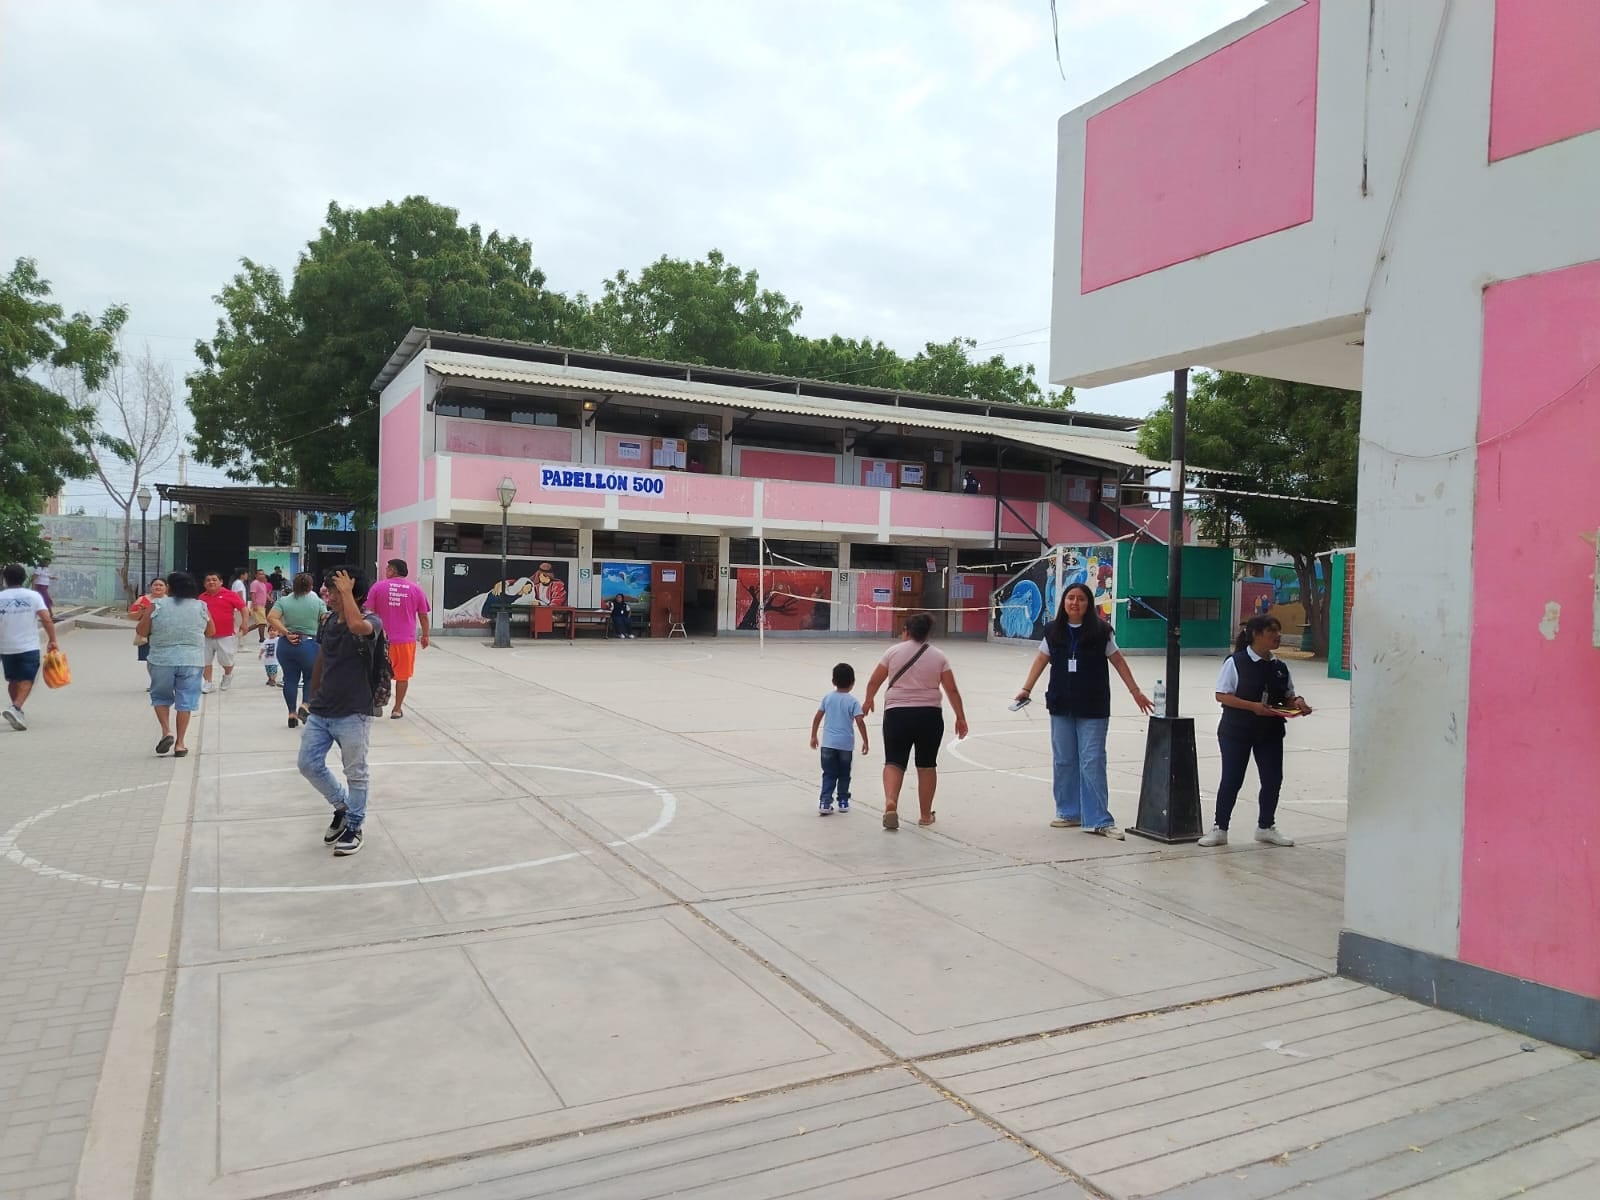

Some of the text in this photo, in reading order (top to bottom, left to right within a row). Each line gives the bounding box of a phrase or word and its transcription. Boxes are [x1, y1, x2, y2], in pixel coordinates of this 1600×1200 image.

[632, 476, 664, 494] 500
[423, 559, 432, 569] S
[581, 569, 589, 578] S
